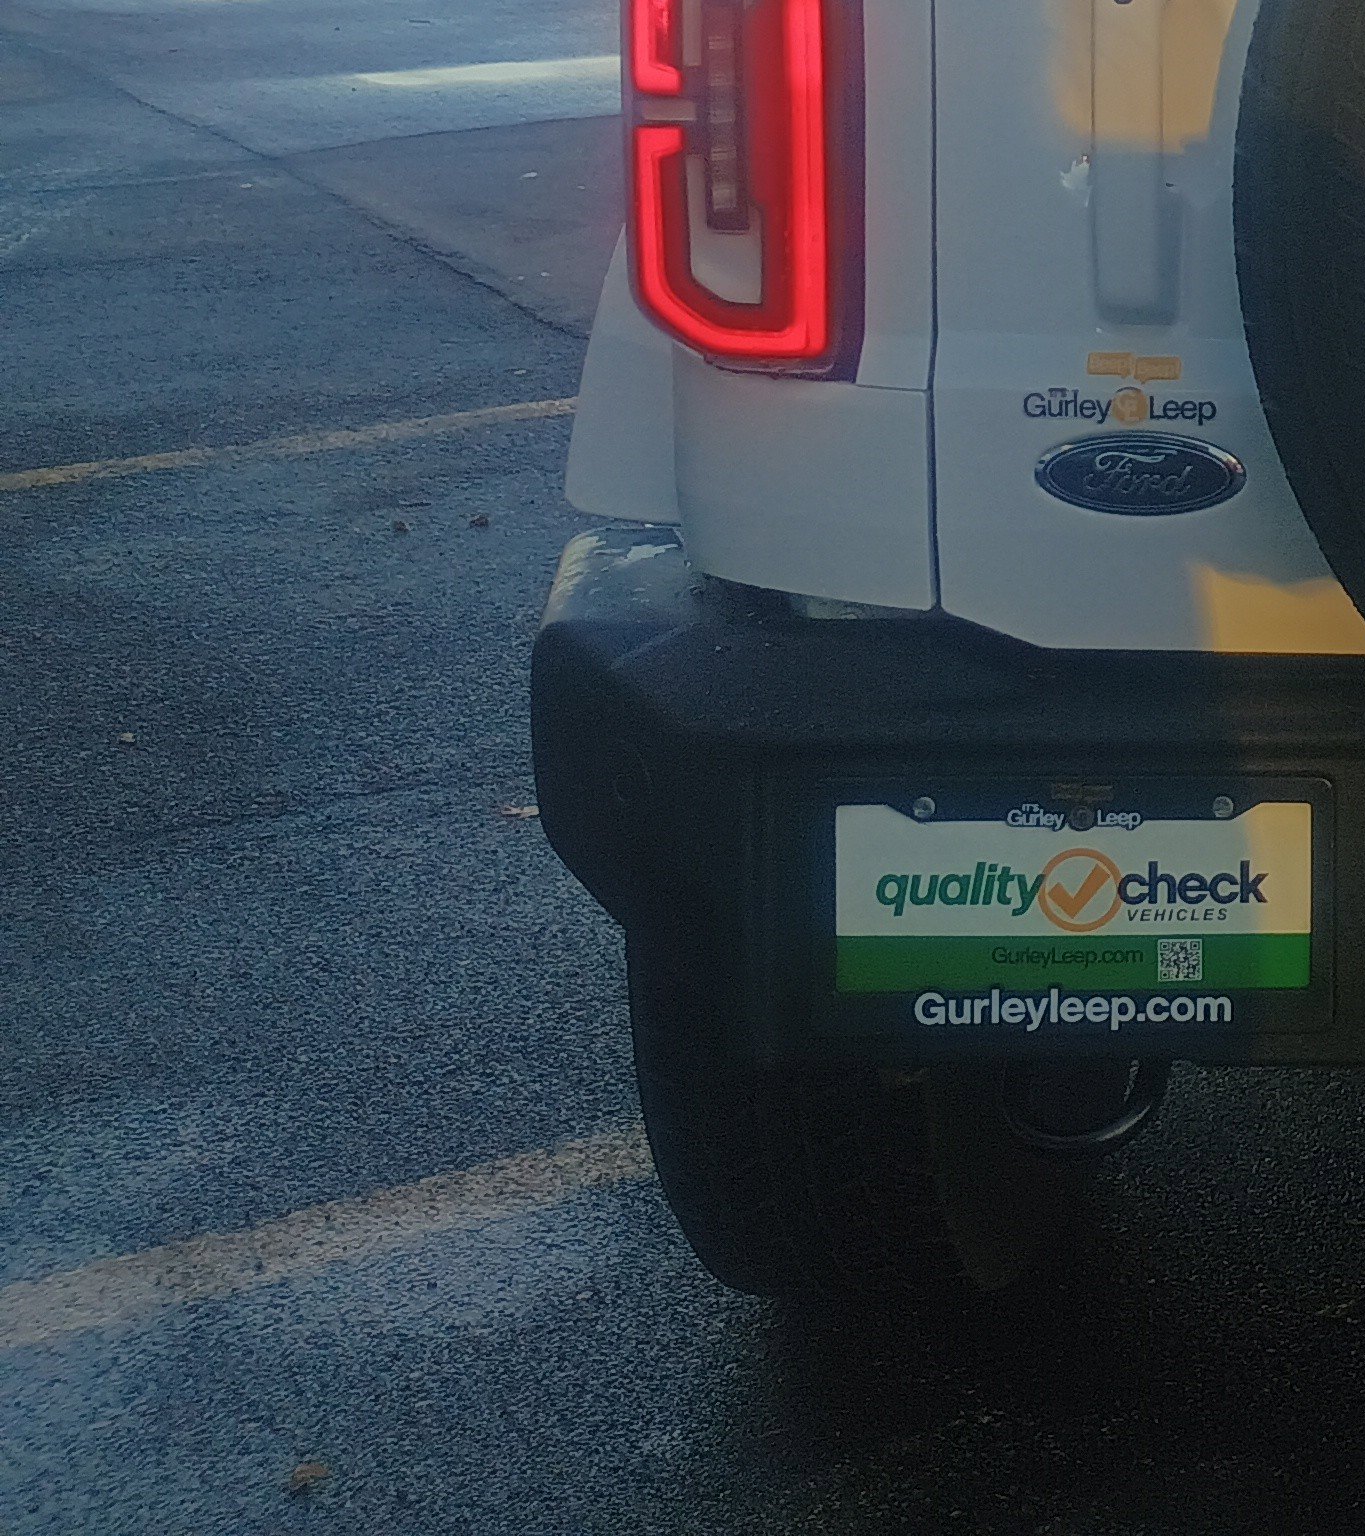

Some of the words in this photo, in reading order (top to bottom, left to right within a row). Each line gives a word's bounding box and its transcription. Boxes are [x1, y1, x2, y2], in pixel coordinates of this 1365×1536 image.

[1023, 389, 1112, 424] Gurley
[1149, 395, 1217, 426] Leep
[1083, 449, 1194, 496] Ford
[1006, 808, 1065, 830] Gurley
[1097, 809, 1141, 830] Leep
[876, 861, 1046, 917] quality
[1117, 860, 1269, 905] check
[1126, 908, 1228, 922] VEHICLES
[991, 946, 1144, 969] GurleyLeep.com
[914, 989, 1233, 1031] Gurleyleep.com
